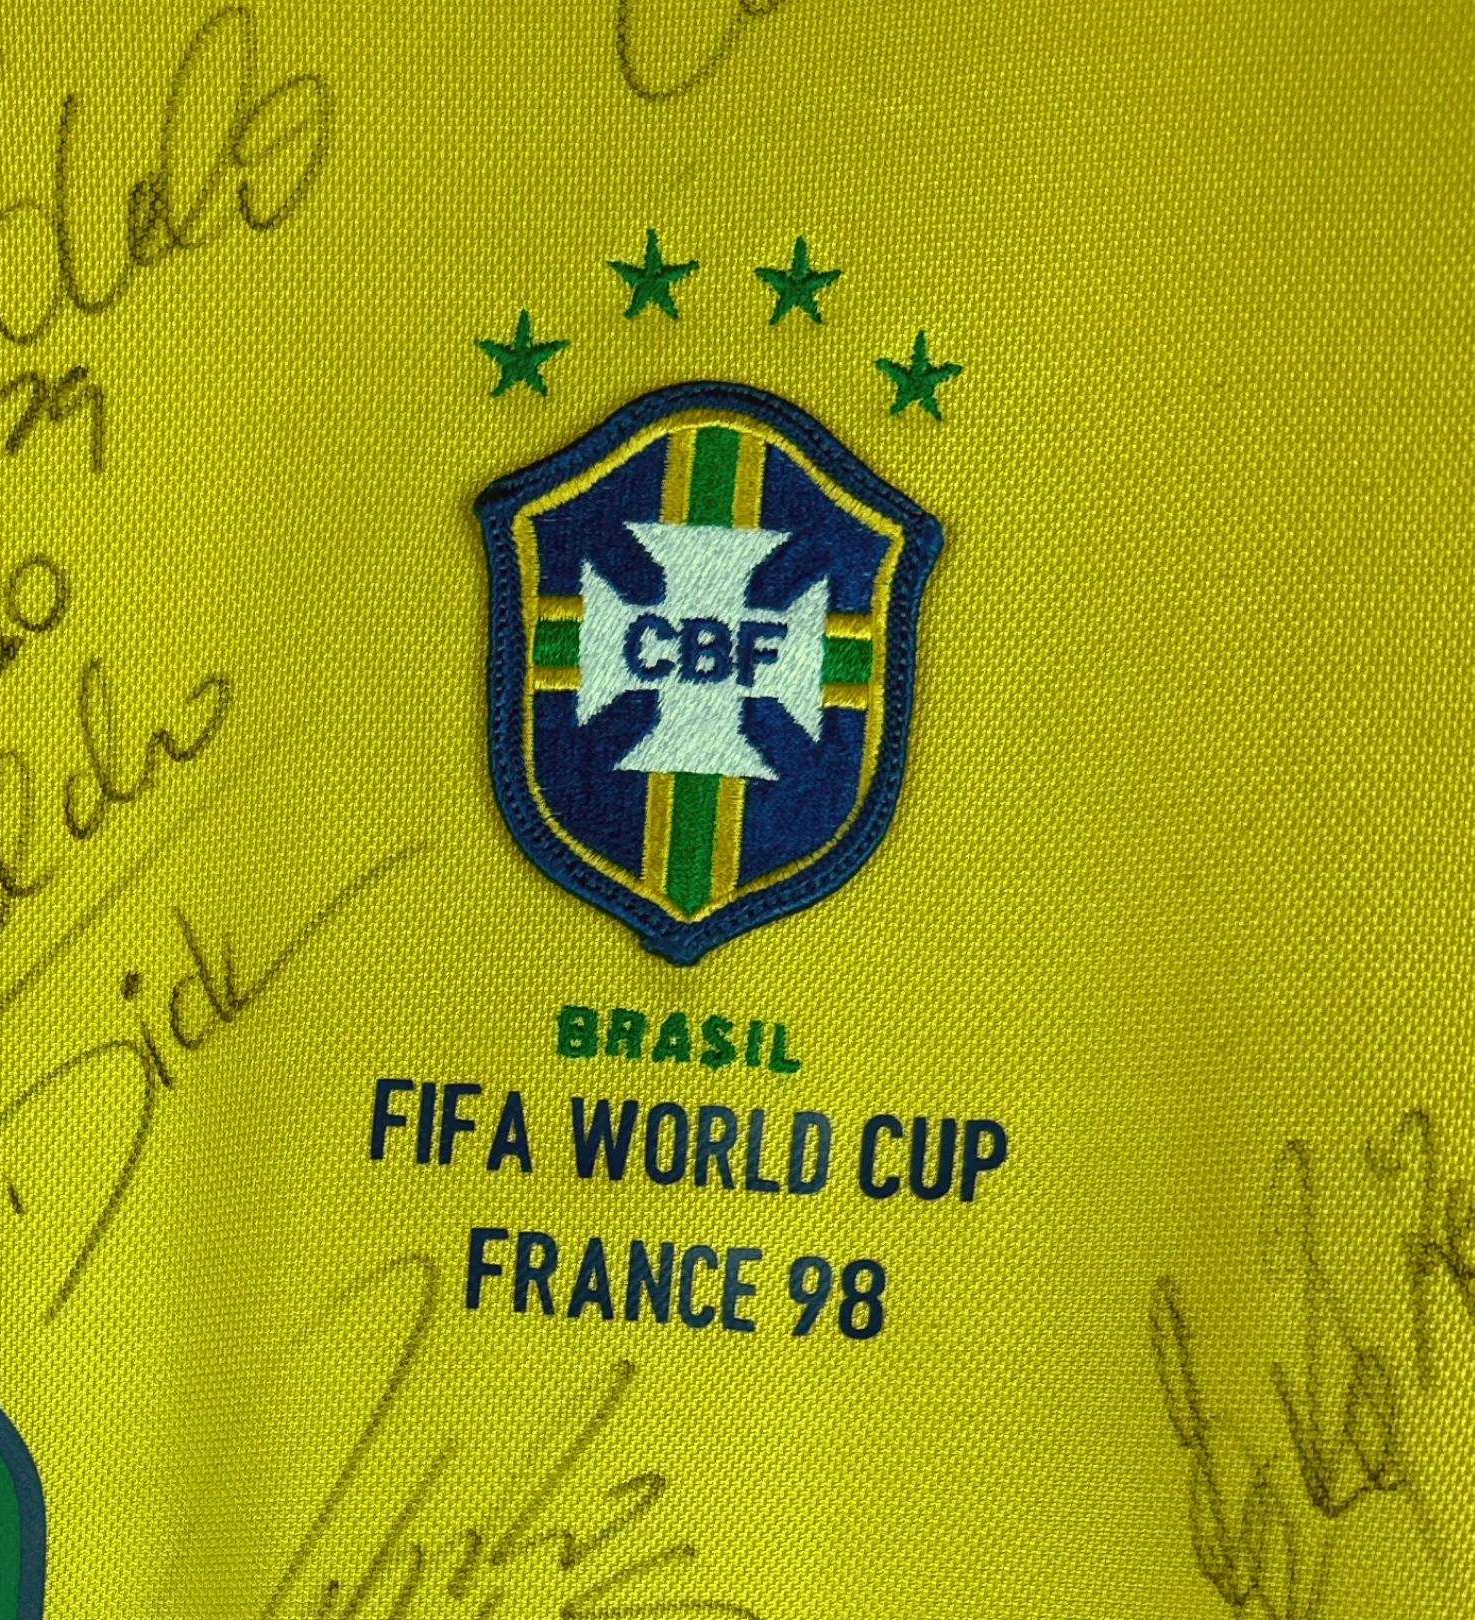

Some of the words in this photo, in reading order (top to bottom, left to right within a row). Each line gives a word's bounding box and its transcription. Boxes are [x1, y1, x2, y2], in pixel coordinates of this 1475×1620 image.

[622, 612, 788, 688] CBF
[555, 1003, 802, 1075] BRASIL
[369, 1078, 534, 1174] FIFA
[569, 1096, 833, 1195] WORLD
[859, 1113, 1008, 1203] CUP
[464, 1227, 763, 1333] FRANCE
[787, 1255, 887, 1340] 98
